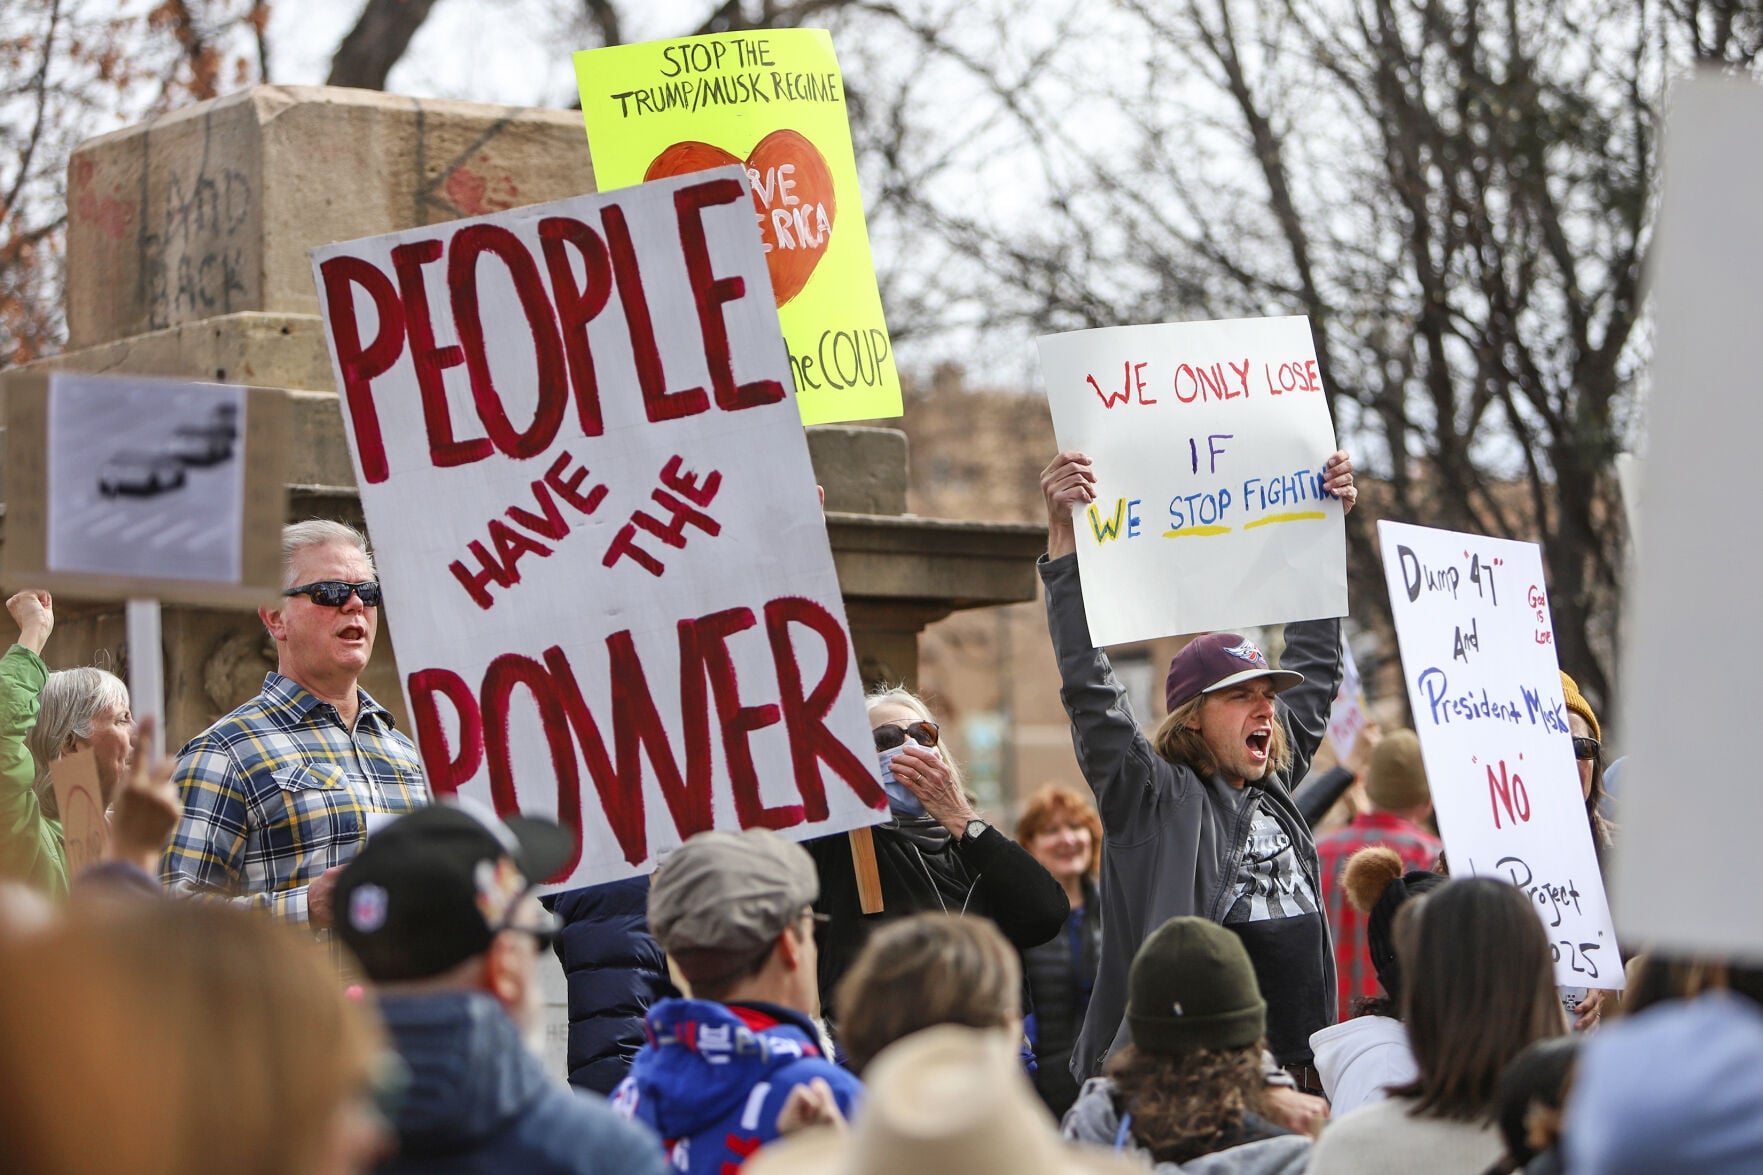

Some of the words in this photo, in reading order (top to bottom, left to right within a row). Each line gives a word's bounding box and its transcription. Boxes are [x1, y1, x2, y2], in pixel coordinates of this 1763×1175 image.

[660, 40, 727, 77] STOP
[732, 38, 776, 69] THE
[610, 72, 770, 118] TRUMP/MUSK
[770, 71, 840, 103] REGIME
[320, 178, 787, 485] PEOPLE
[783, 336, 822, 393] he
[818, 328, 888, 391] COUP
[1086, 360, 1157, 410] WE
[1174, 358, 1250, 404] ONLY
[1265, 358, 1321, 396] LOSE
[1188, 433, 1234, 476] IF
[448, 450, 611, 610] HAVE
[602, 453, 724, 578] THE
[1087, 497, 1142, 546] WE
[1168, 487, 1232, 531] STOP
[1243, 465, 1340, 512] FIGHTIN
[1396, 543, 1461, 603] Dump
[1453, 617, 1480, 664] And
[1417, 666, 1522, 726] President
[407, 595, 889, 884] POWER
